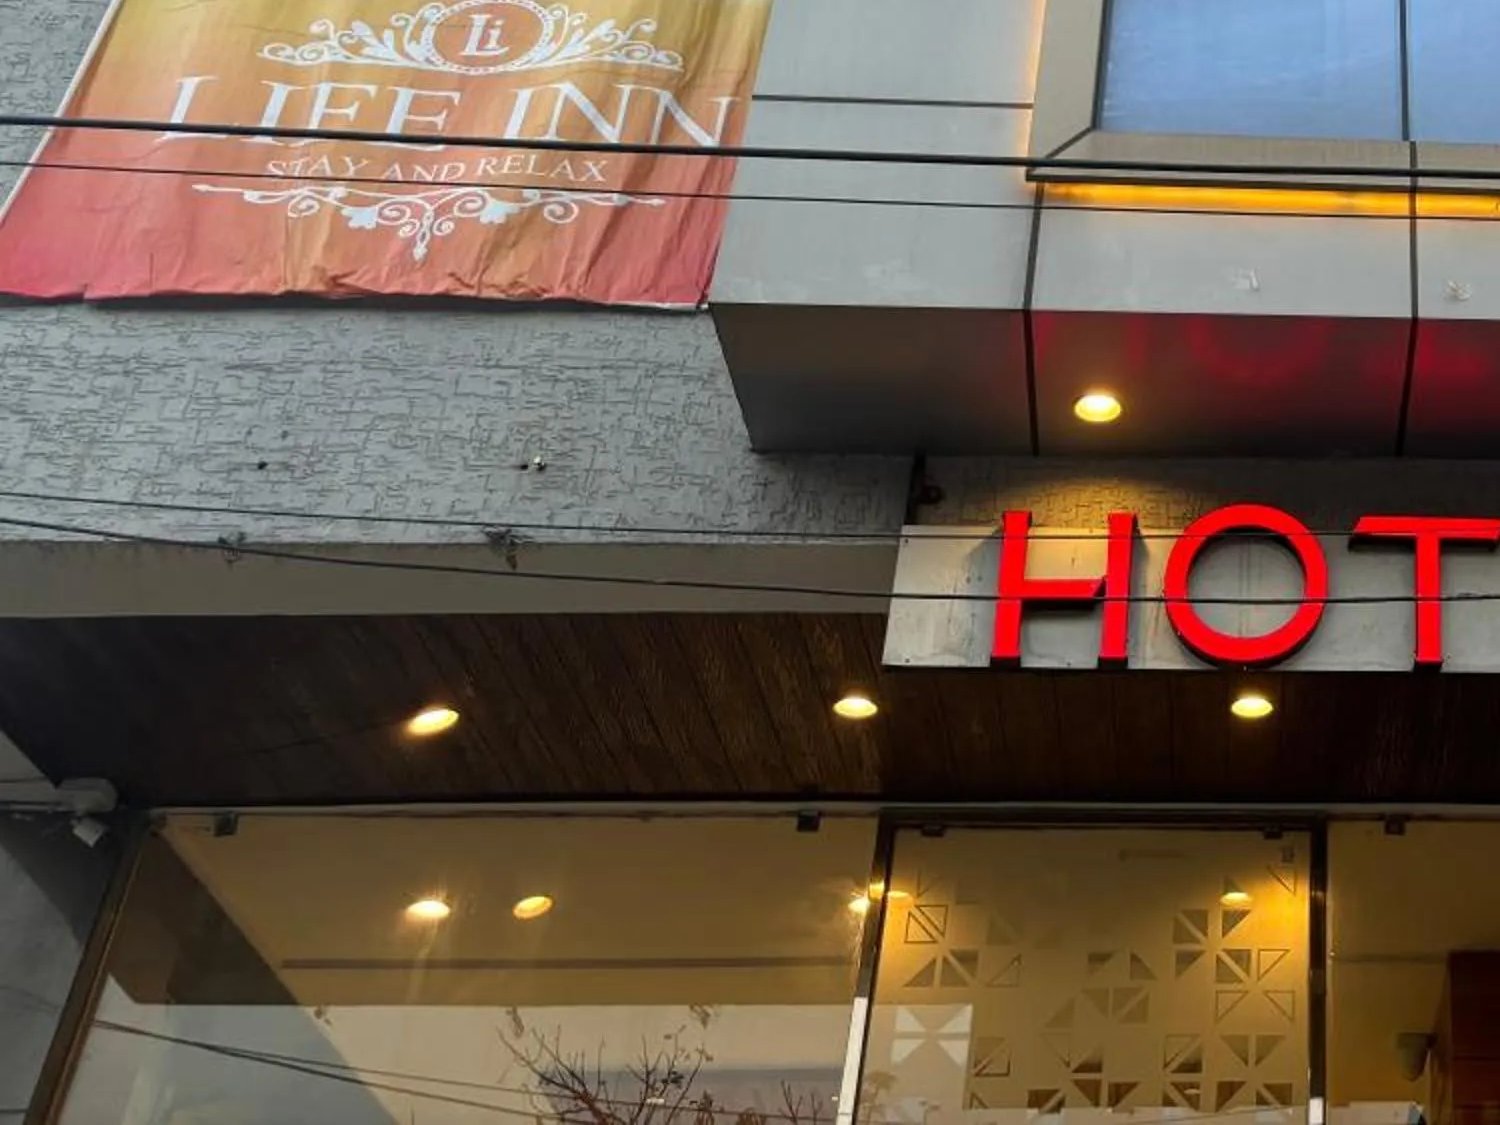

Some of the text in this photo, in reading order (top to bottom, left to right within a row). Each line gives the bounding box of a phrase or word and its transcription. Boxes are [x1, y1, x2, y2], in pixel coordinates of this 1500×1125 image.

[152, 74, 741, 152] LIFE INN
[266, 153, 608, 183] STAY AND RELAX
